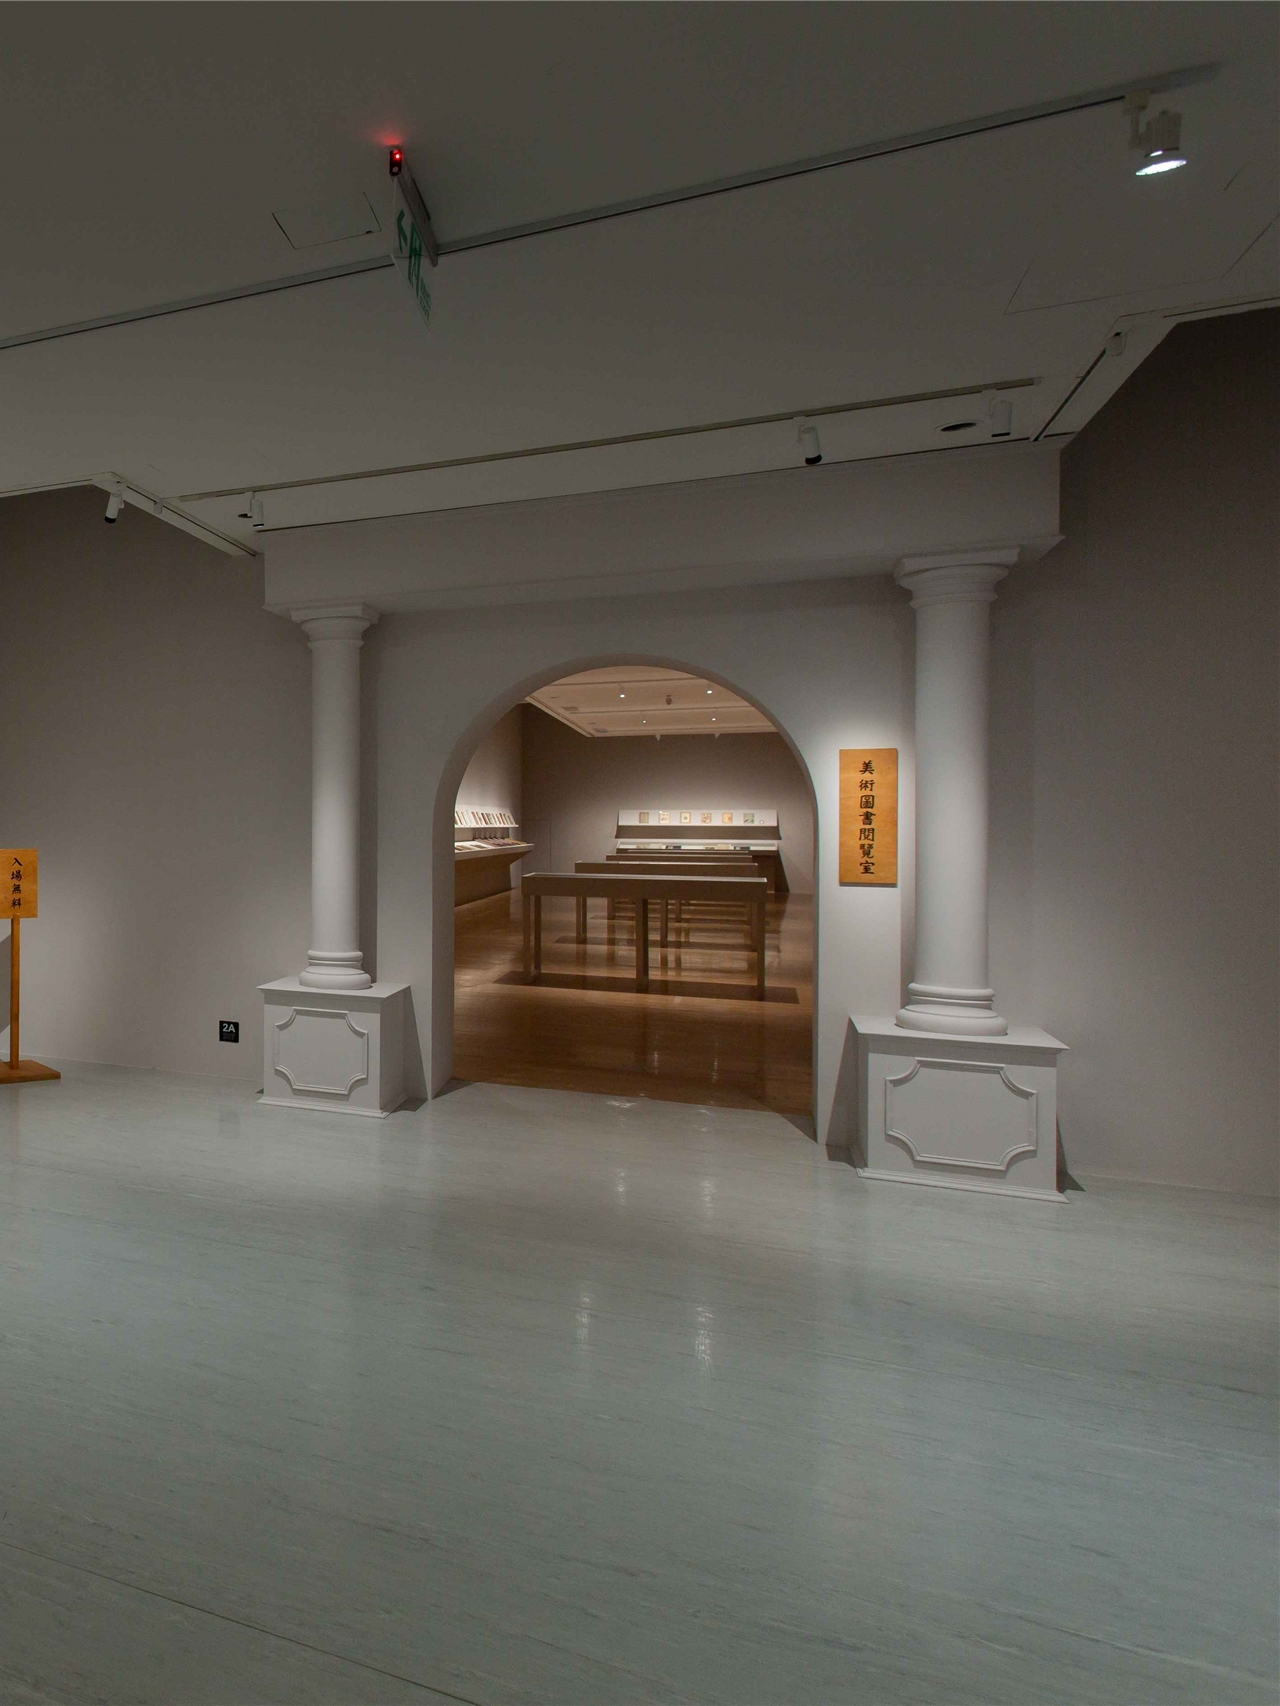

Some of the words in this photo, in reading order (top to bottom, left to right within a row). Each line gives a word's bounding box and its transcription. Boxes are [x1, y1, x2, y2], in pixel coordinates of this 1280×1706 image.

[10, 857, 23, 909] 入場無料
[222, 1023, 236, 1033] 2A
